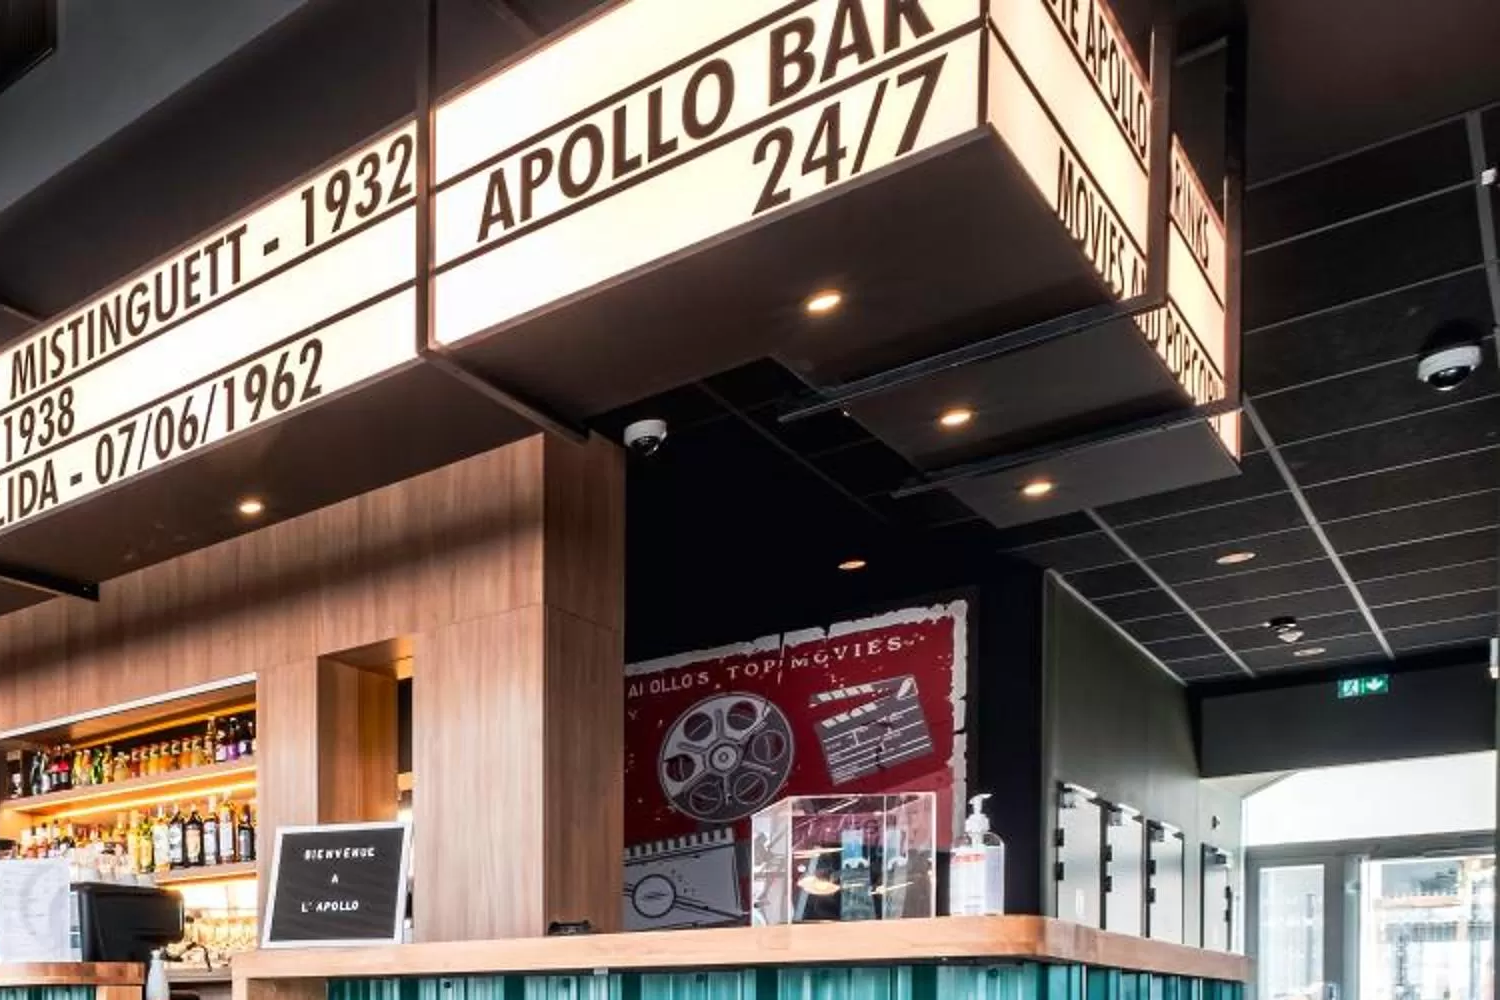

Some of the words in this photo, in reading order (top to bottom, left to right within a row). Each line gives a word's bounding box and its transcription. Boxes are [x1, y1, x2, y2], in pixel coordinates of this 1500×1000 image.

[476, 58, 735, 243] APOLLO
[752, 53, 948, 215] 24/7
[1086, 0, 1147, 159] APOLLO
[10, 224, 248, 400] MISTINGUETT
[263, 237, 280, 256] -
[301, 133, 414, 247] 1932
[1057, 147, 1125, 301] MOVIES
[3, 386, 76, 462] 1938
[70, 473, 83, 486] -
[95, 338, 323, 485] 07/06/1962
[727, 659, 776, 681] TOP
[304, 847, 375, 860] BIENVENUE
[331, 873, 339, 883] A
